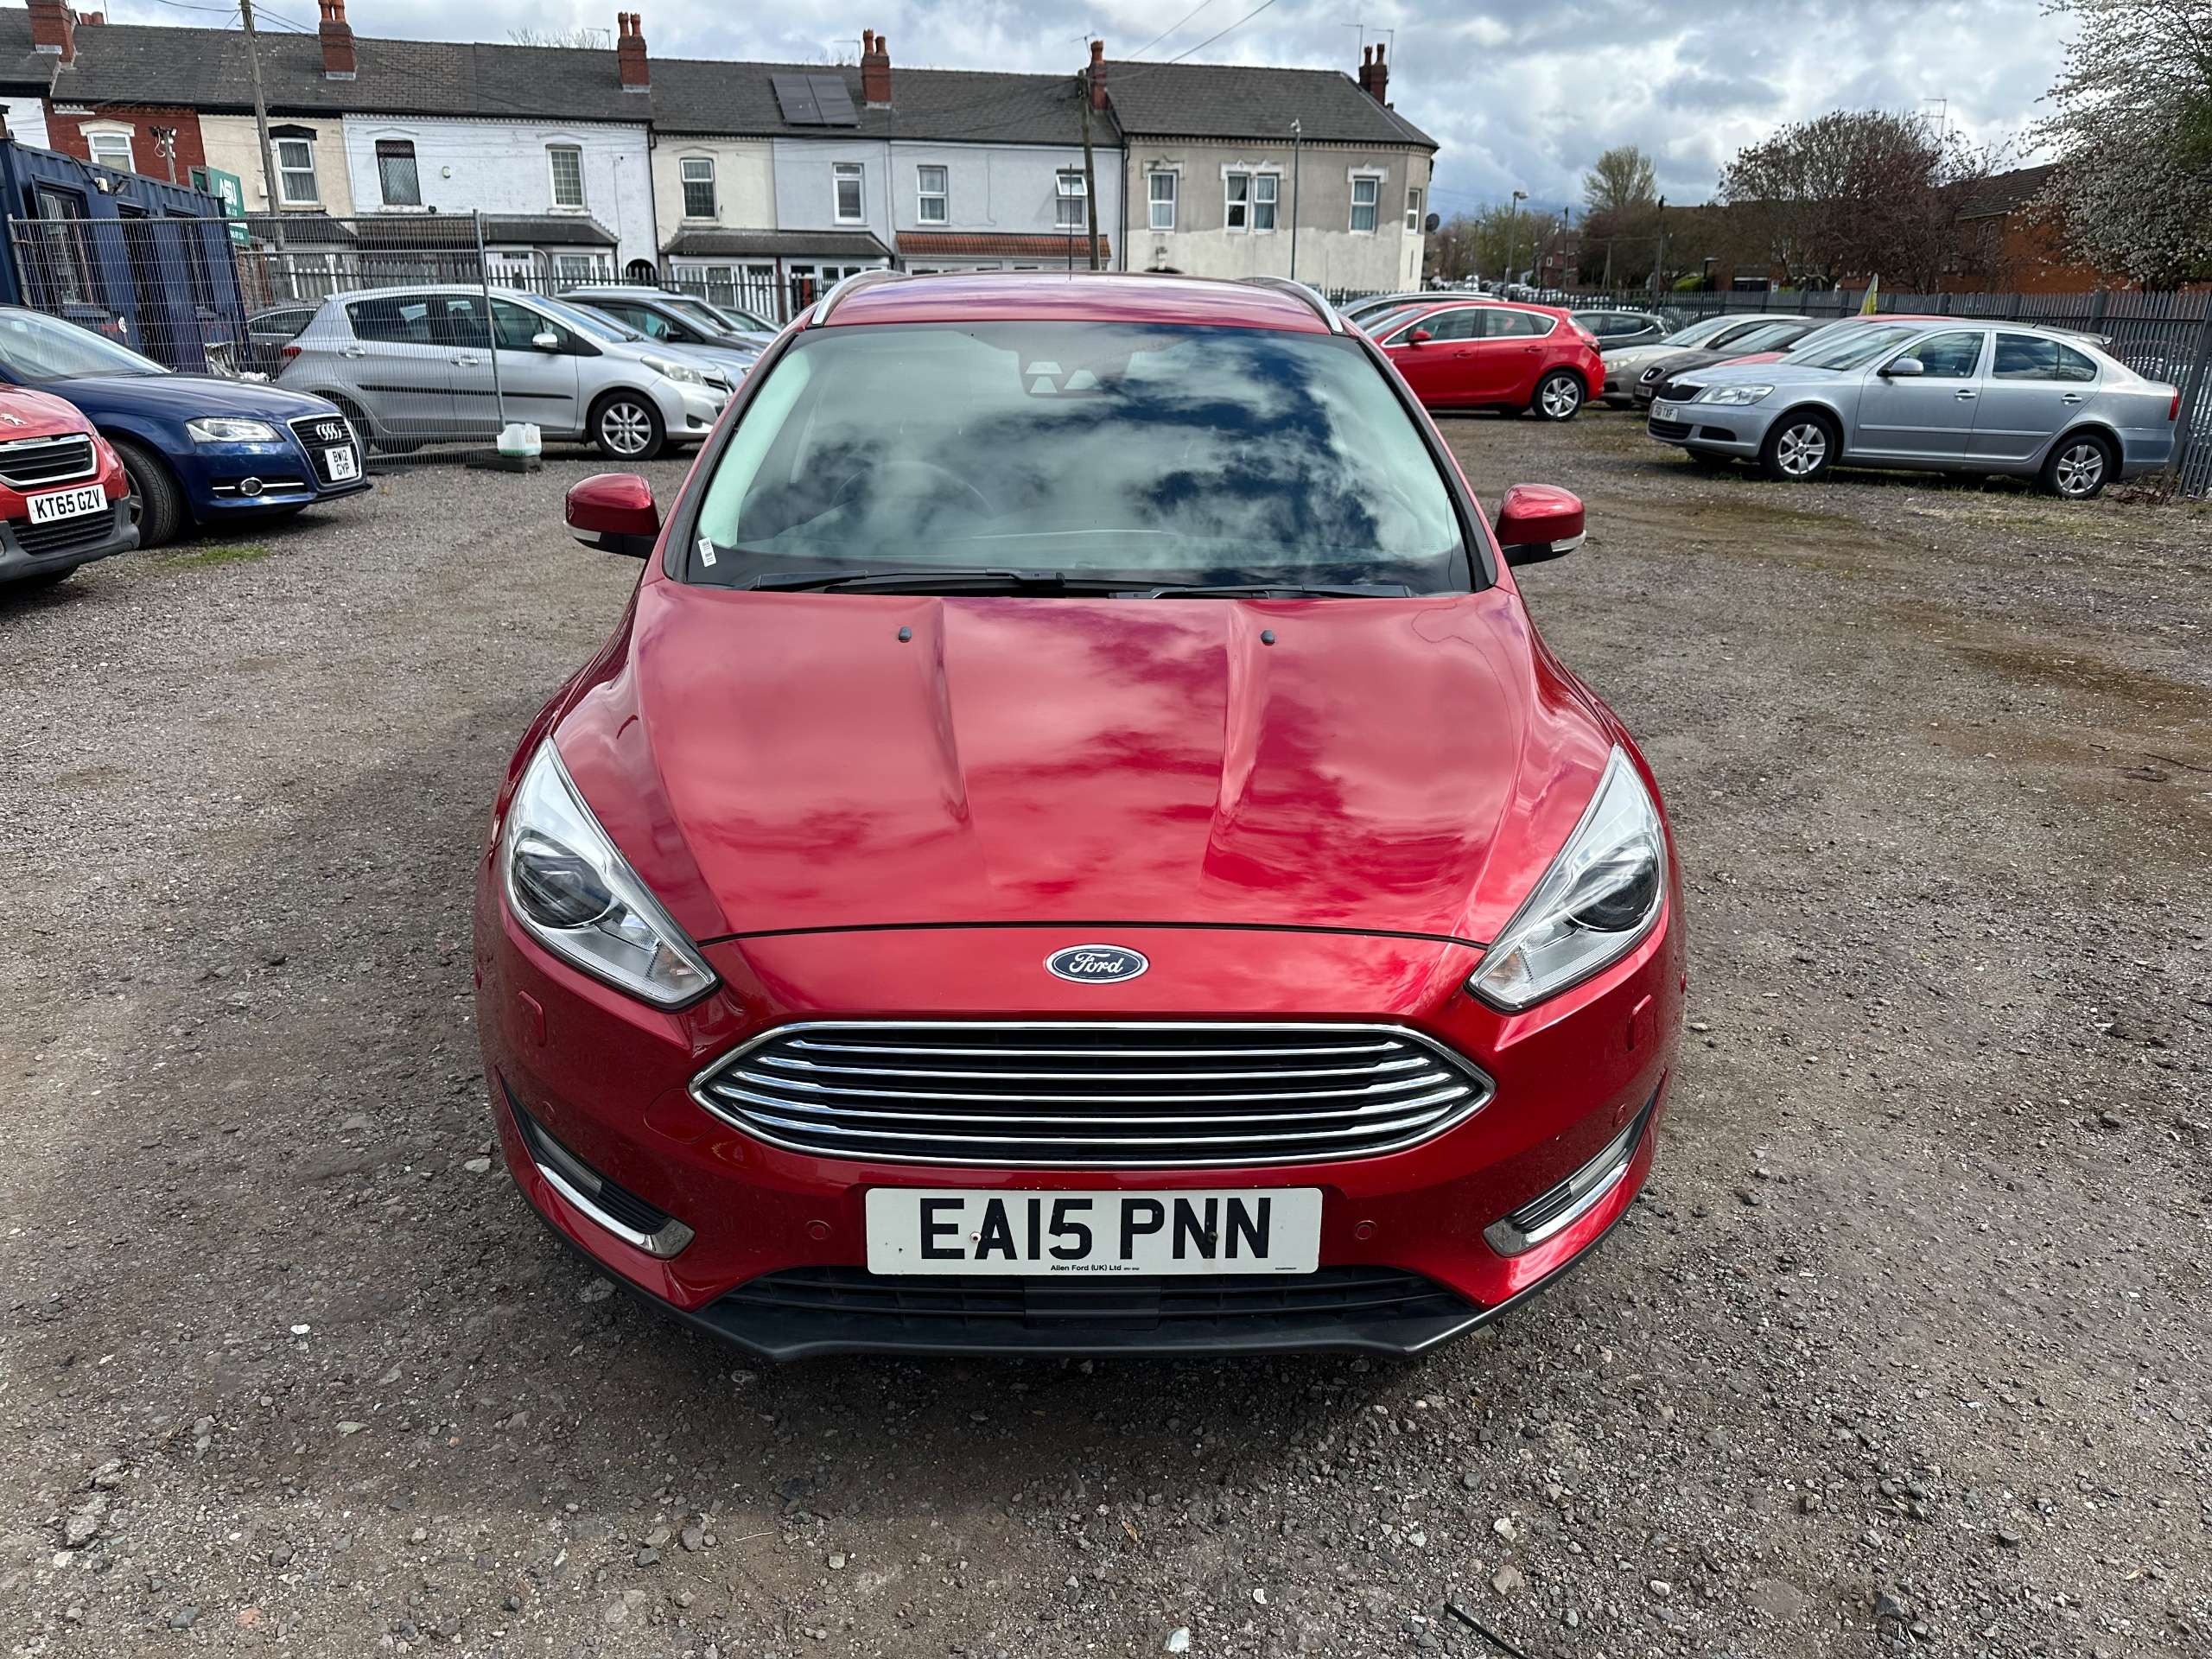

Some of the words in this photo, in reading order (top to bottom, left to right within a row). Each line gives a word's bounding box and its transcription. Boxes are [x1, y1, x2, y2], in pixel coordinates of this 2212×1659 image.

[333, 449, 348, 462] BW12
[336, 463, 350, 475] GYP
[35, 493, 75, 519] KT65
[77, 488, 100, 511] GZV
[1069, 952, 1124, 973] Ford
[919, 1197, 1093, 1260] EA15
[1119, 1197, 1272, 1260] PNN
